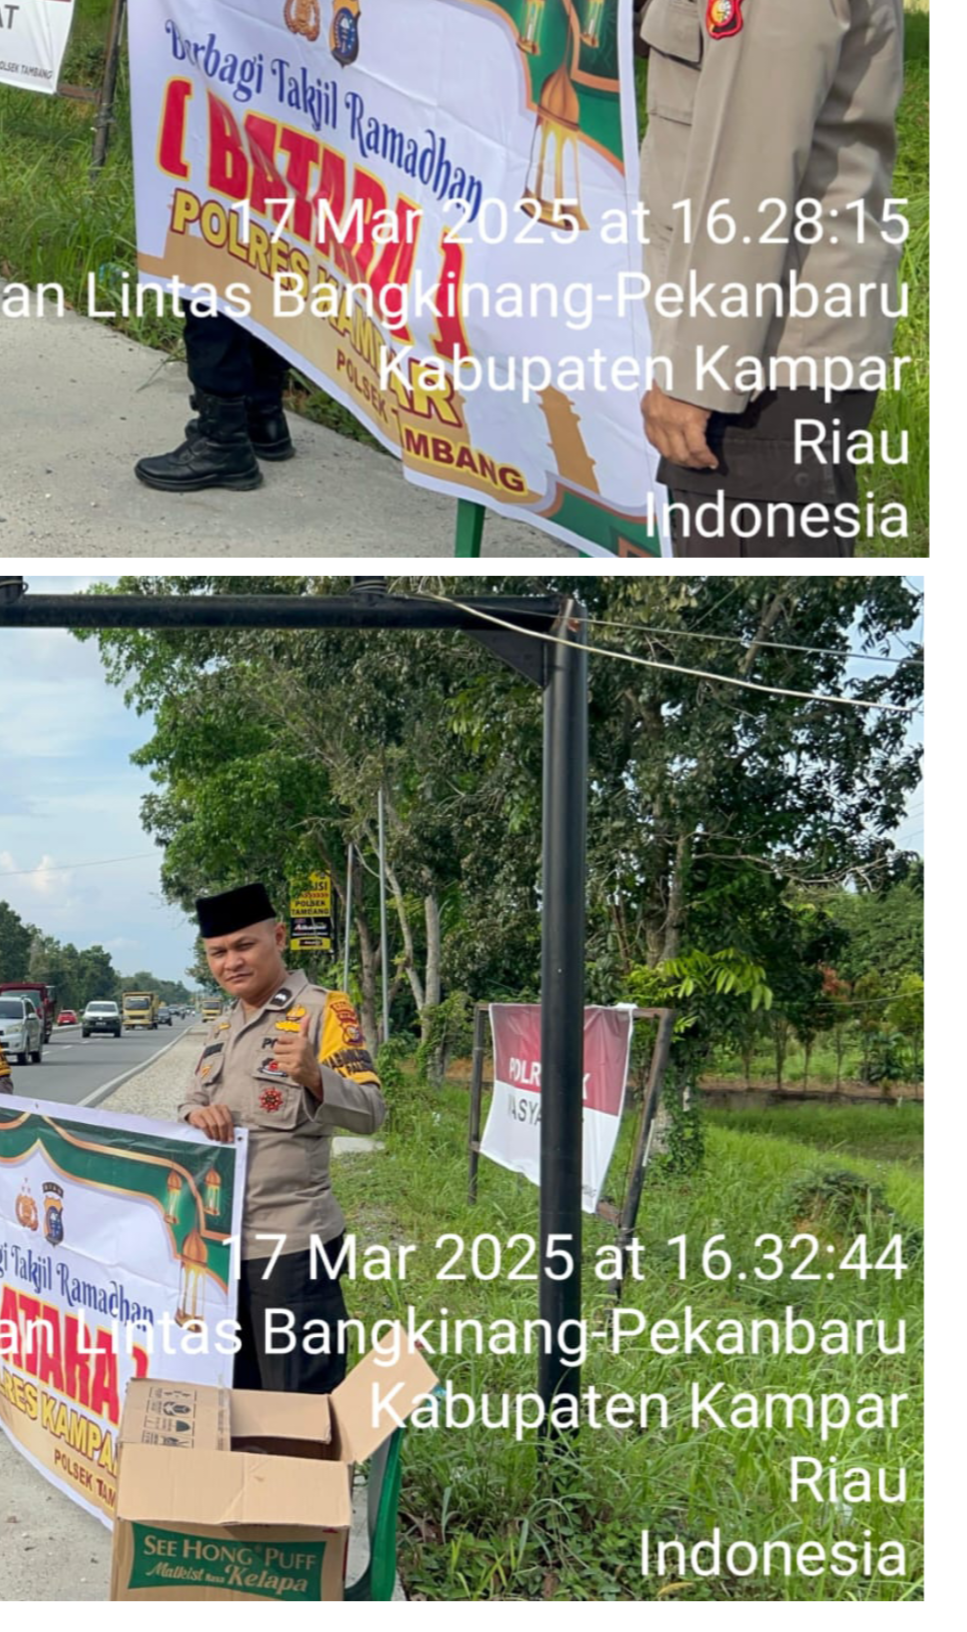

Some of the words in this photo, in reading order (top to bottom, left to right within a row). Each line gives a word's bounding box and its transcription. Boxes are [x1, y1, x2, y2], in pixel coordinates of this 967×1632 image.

[270, 58, 337, 132] Takjil
[345, 91, 483, 222] Ramadhan
[170, 188, 310, 301] POLRES
[336, 348, 390, 424] POLSEK
[391, 408, 526, 493] TMBANG
[10, 1244, 52, 1294] Takjil
[56, 1262, 154, 1332] Ramadhan
[54, 1448, 94, 1492] POLSEK
[143, 1534, 178, 1558] SEE
[183, 1538, 253, 1566] HONG
[264, 1547, 317, 1571] PUFF
[224, 1563, 309, 1596] Kelapa
